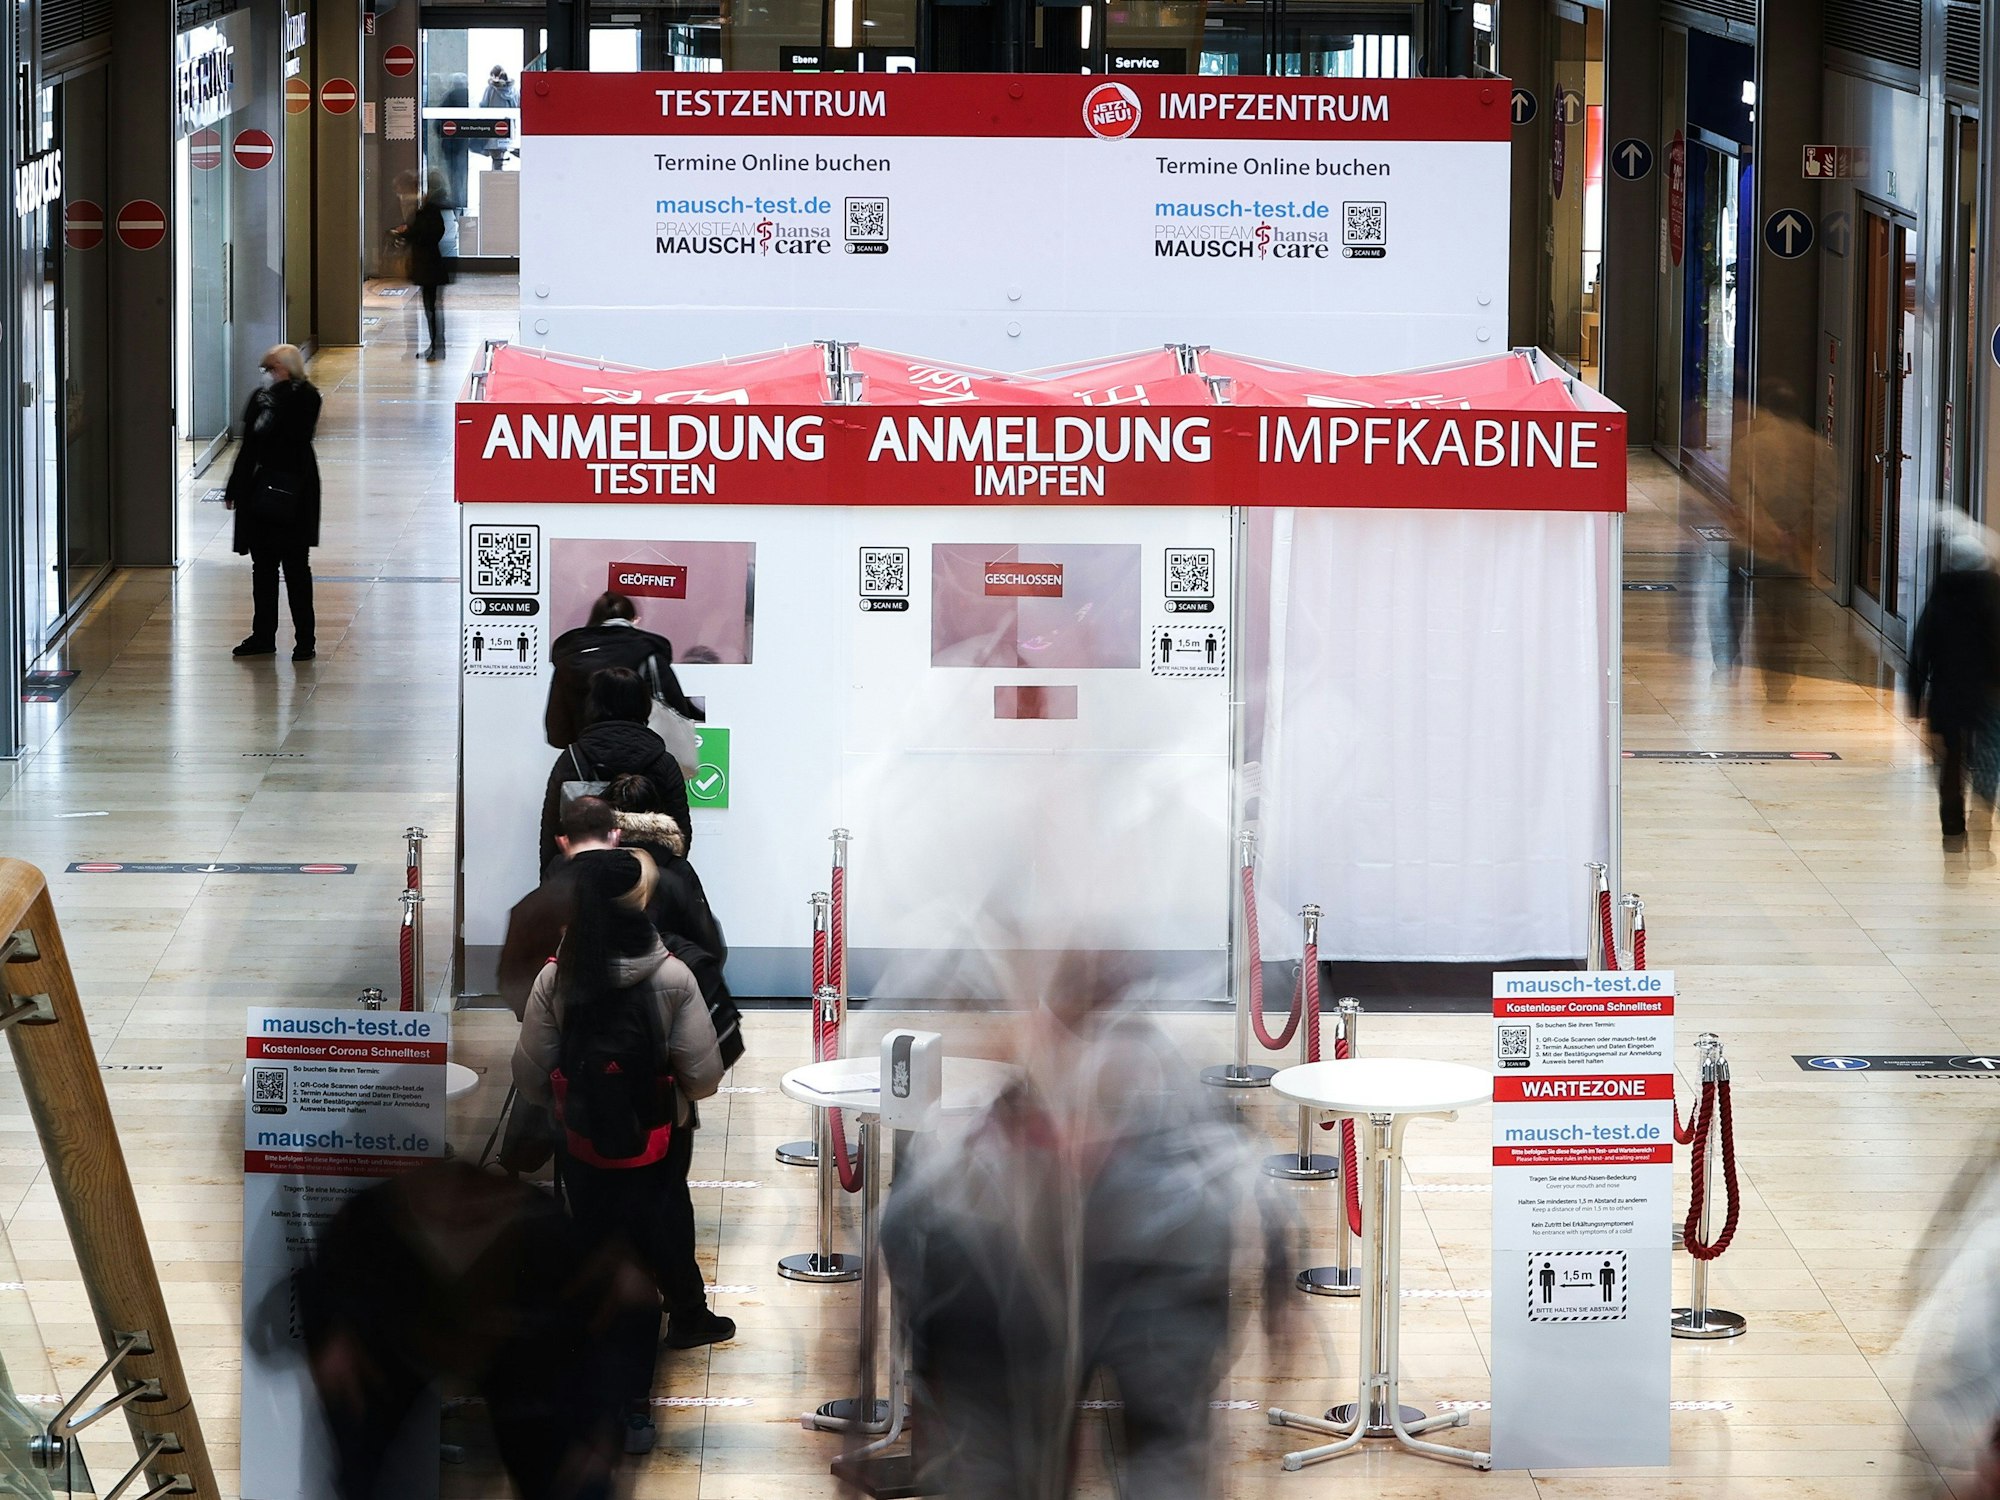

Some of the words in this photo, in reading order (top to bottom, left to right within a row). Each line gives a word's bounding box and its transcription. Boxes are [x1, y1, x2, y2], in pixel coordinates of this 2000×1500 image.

[792, 55, 818, 64] Ebene
[1115, 56, 1159, 69] Service
[655, 89, 886, 117] TESTZENTRUM
[1159, 92, 1389, 122] IMPFZENTRUM
[1093, 108, 1132, 126] NEU!
[654, 154, 737, 171] Termine
[742, 154, 809, 171] Online
[815, 154, 891, 171] buchen
[1156, 157, 1238, 175] Termine
[1244, 157, 1310, 175] Online
[1316, 158, 1390, 176] buchen
[656, 196, 831, 214] mausch-test.de
[1155, 200, 1329, 218] mausch-test.de
[656, 221, 756, 236] PRAXISTEAM
[775, 223, 831, 238] hansa
[1155, 224, 1254, 240] PRAXISTEAM
[1274, 227, 1328, 242] hansa
[656, 237, 755, 254] MAUSCH
[775, 238, 831, 254] care
[1155, 240, 1254, 258] MAUSCH
[1273, 243, 1329, 259] care
[481, 414, 825, 461] ANMELDUNG
[867, 416, 1212, 463] ANMELDUNG
[1258, 415, 1598, 469] IMPFKABINE
[586, 463, 715, 495] TESTEN
[975, 465, 1104, 496] IMPFEN
[619, 573, 676, 587] GEÖFFNET
[985, 573, 1062, 585] GESCHLOSSEN
[489, 603, 514, 612] SCAN
[516, 603, 530, 612] ME
[873, 602, 891, 610] SCAN
[892, 602, 903, 610] ME
[490, 638, 503, 647] 1,5
[1178, 639, 1190, 648] 1,5
[1507, 976, 1661, 993] mausch-test.de
[1506, 1003, 1567, 1013] Kostenloser
[1568, 1002, 1605, 1012] Corona
[1607, 1001, 1662, 1012] Schnelltest
[263, 1017, 430, 1037] mausch-test.de
[262, 1043, 325, 1056] Kostenloser
[328, 1045, 368, 1057] Corona
[371, 1047, 430, 1058] Schnelltest
[1522, 1080, 1645, 1097] WARTEZONE
[258, 1130, 429, 1151] mausch-test.de
[1505, 1124, 1660, 1141] mausch-test.de
[1563, 1270, 1580, 1282] 1,5
[1581, 1272, 1592, 1280] m
